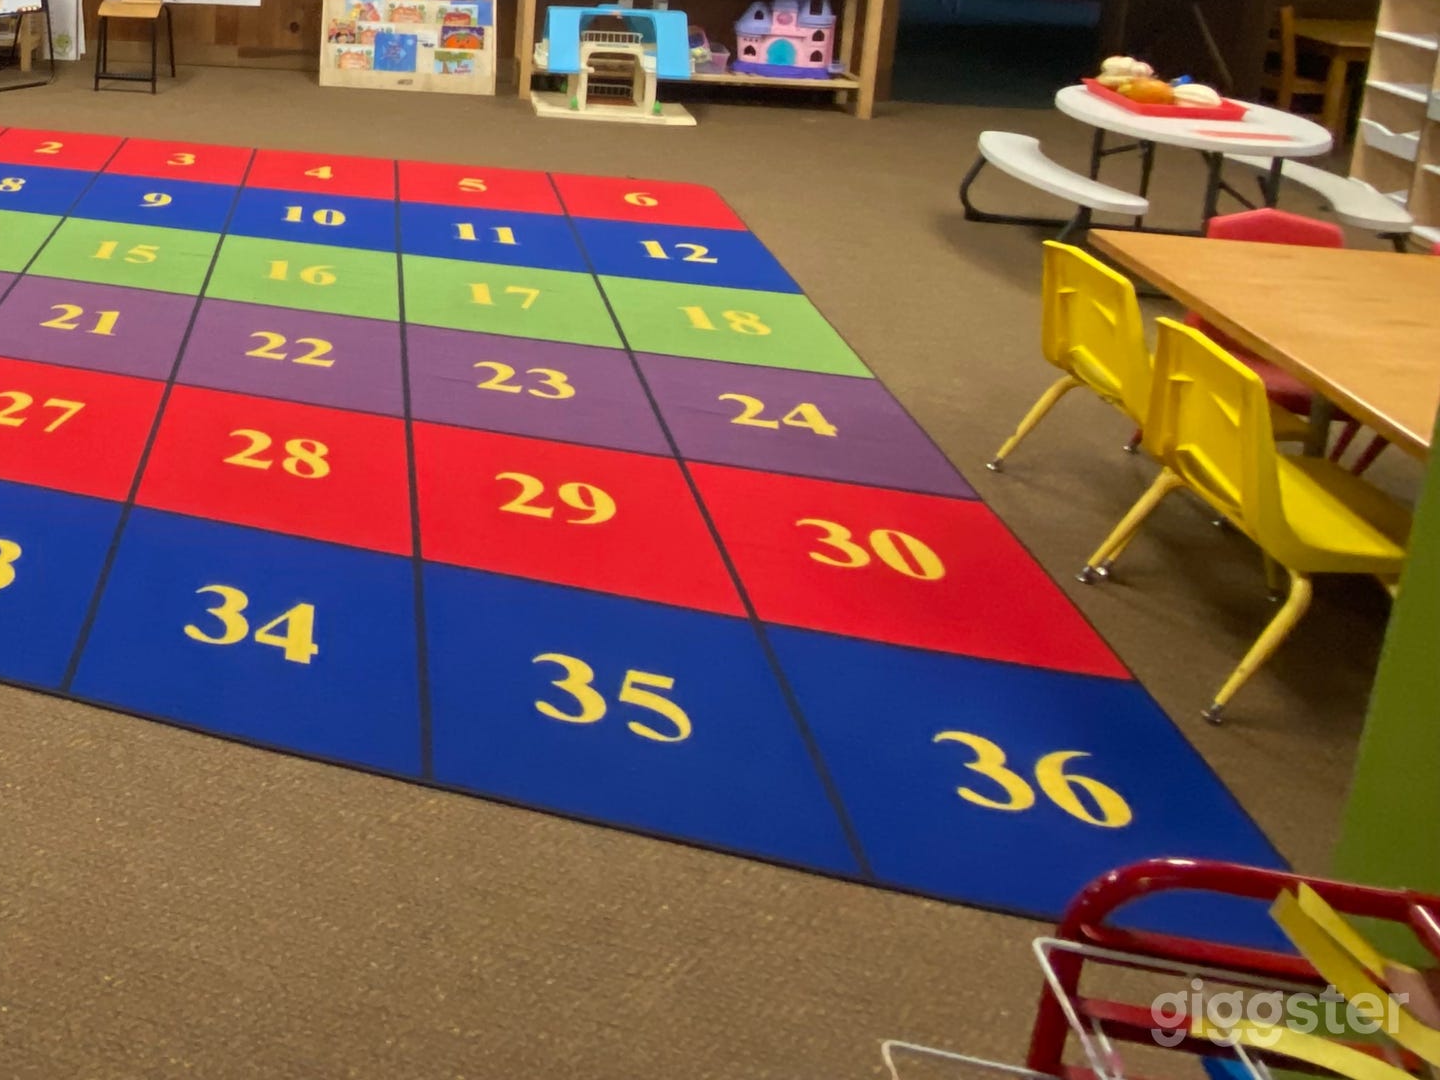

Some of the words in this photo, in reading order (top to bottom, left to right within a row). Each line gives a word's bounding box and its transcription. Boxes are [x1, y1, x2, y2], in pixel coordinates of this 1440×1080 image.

[35, 142, 63, 154] 2
[168, 153, 195, 165] 3
[305, 166, 332, 179] 4
[459, 178, 486, 191] 5
[624, 193, 657, 206] 6
[140, 193, 172, 206] 9
[286, 206, 345, 225] 10
[454, 223, 515, 244] 11
[642, 241, 716, 263] 12
[94, 241, 159, 263] 15
[270, 261, 336, 285] 16
[470, 283, 539, 308] 17
[683, 306, 771, 335] 18
[41, 304, 119, 335] 21
[246, 332, 334, 367] 22
[475, 362, 575, 398] 23
[719, 394, 837, 436] 24
[224, 429, 329, 478] 28
[496, 472, 616, 524] 29
[797, 519, 945, 580] 30
[184, 585, 318, 664] 34
[533, 653, 691, 742] 35
[934, 731, 1132, 827] 36
